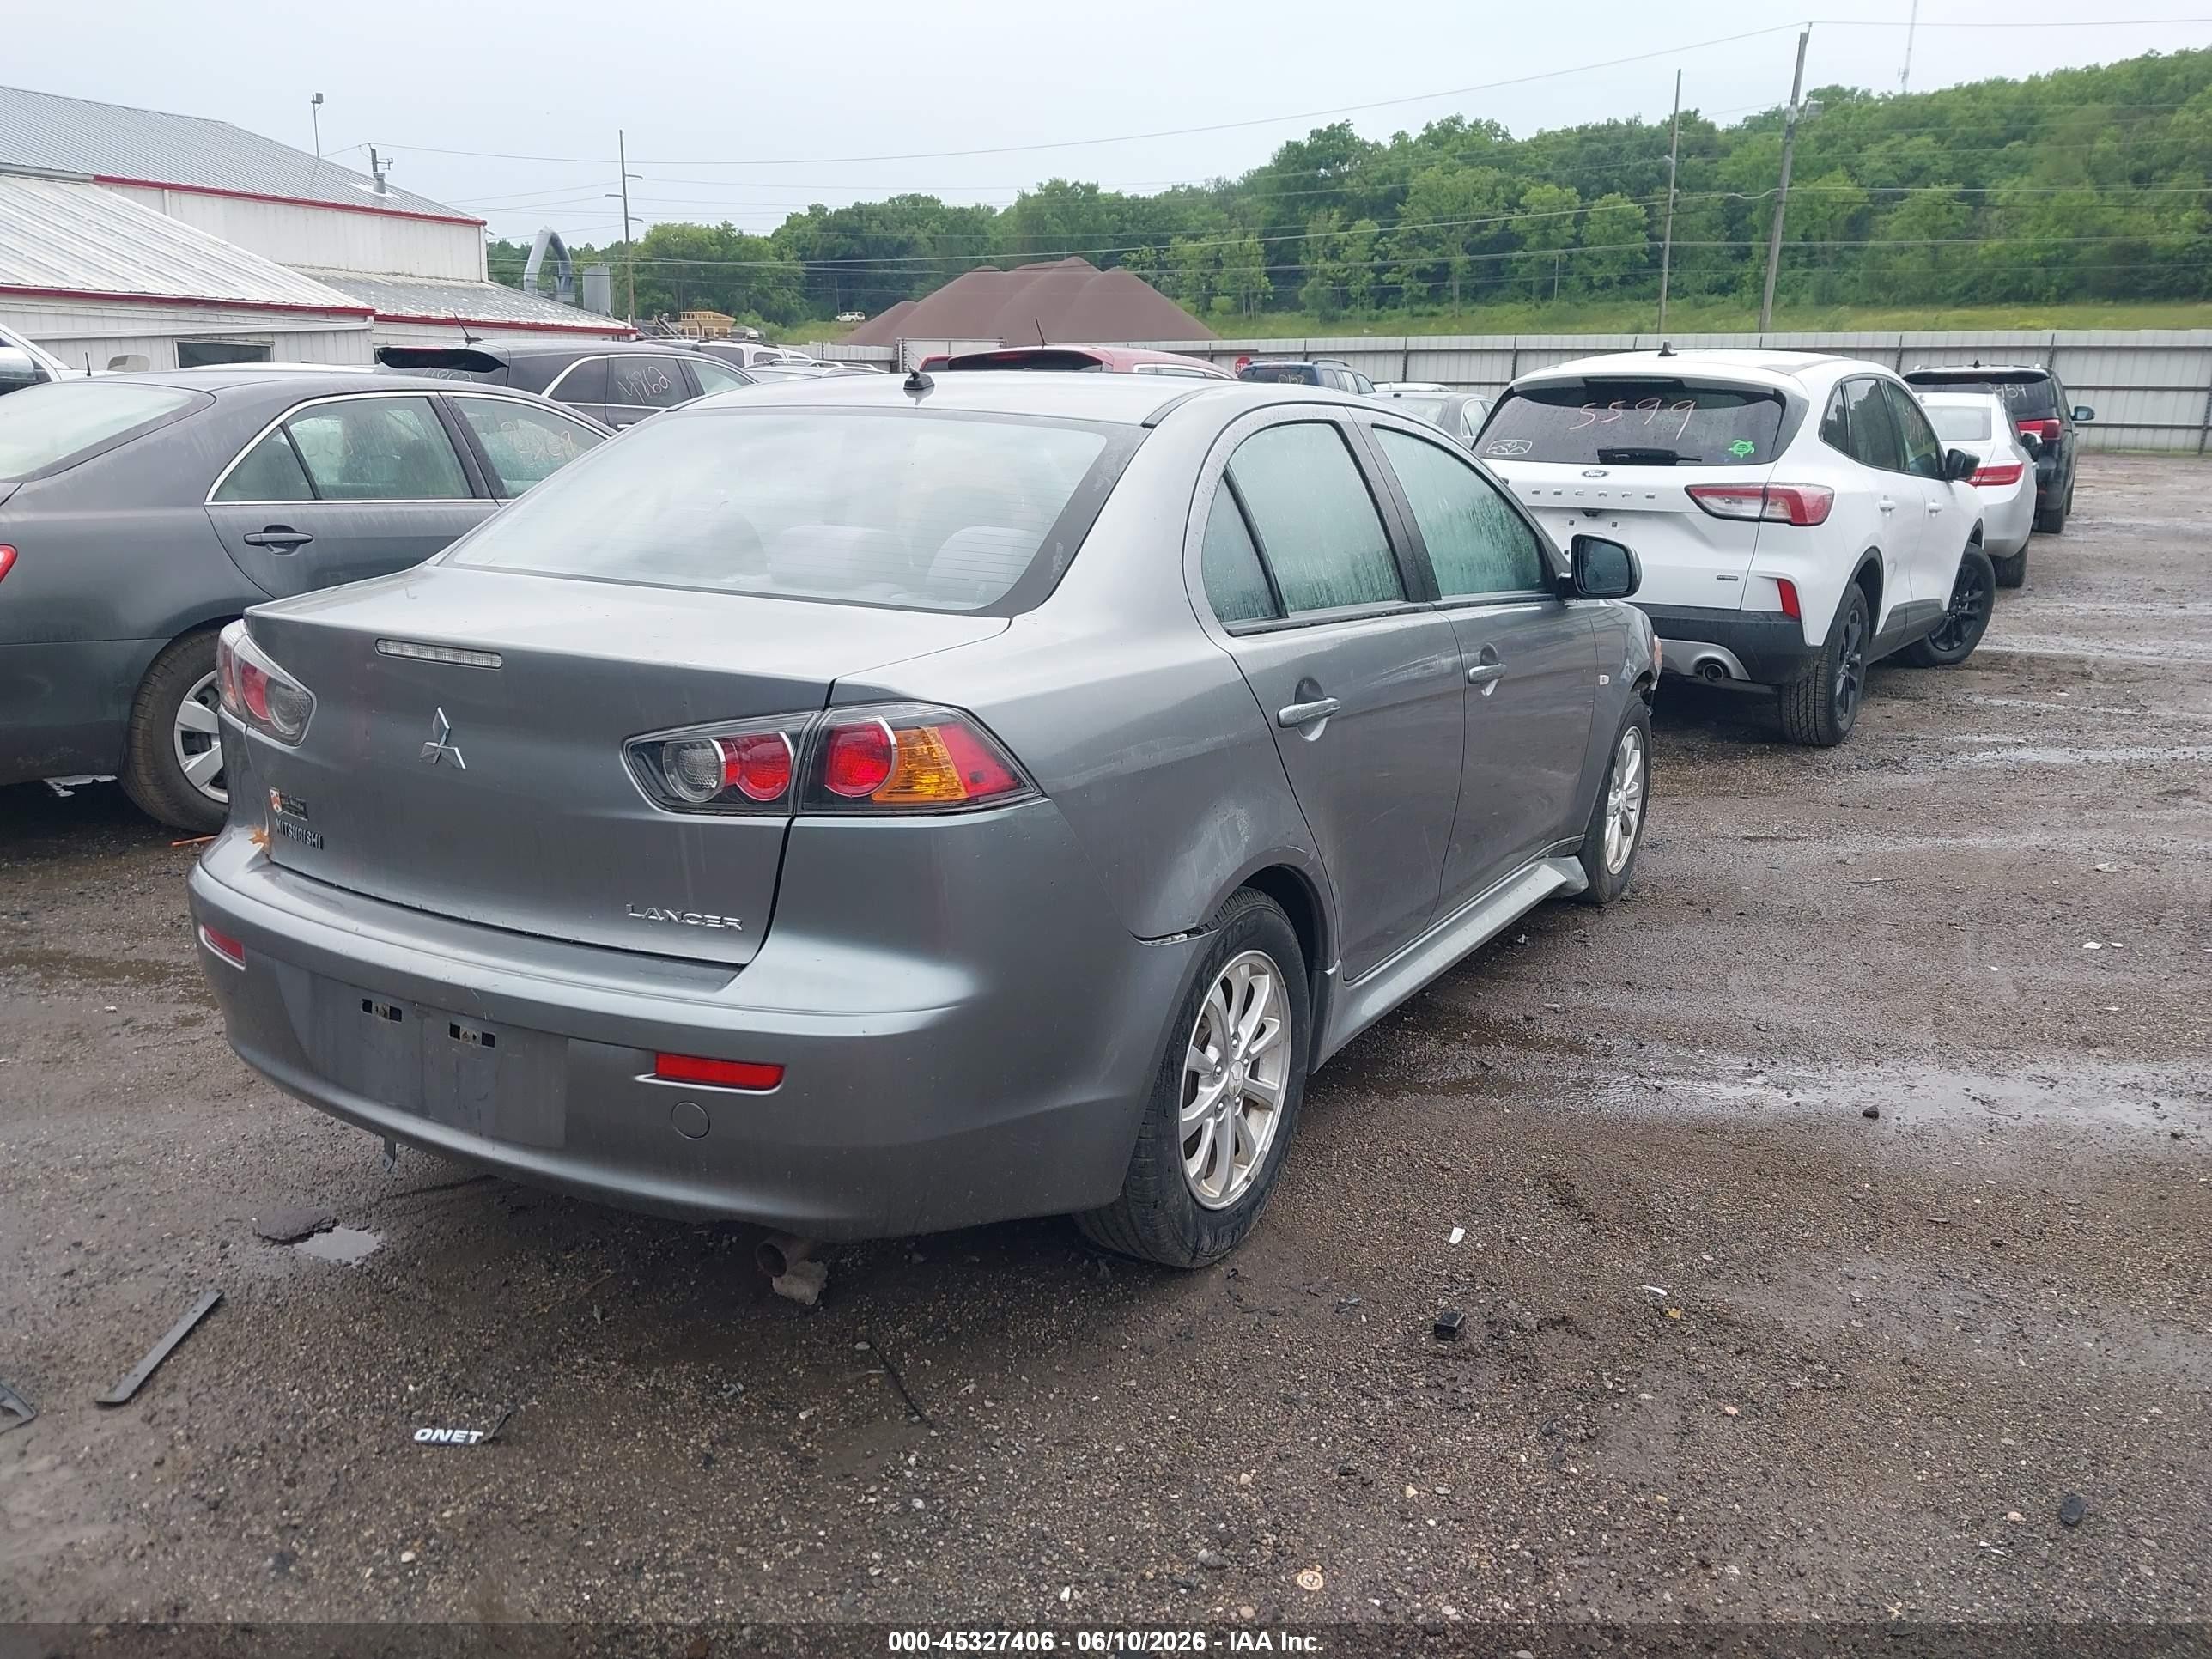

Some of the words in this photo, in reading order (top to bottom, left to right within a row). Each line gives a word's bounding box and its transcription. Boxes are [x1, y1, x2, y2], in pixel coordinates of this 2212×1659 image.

[1980, 382, 2027, 398] 454
[1569, 398, 1697, 440] 5599
[1532, 489, 1656, 499] ESCAPE
[276, 817, 323, 849] MITSUBISHI
[626, 903, 743, 931] LANCER
[414, 1428, 483, 1443] ONET
